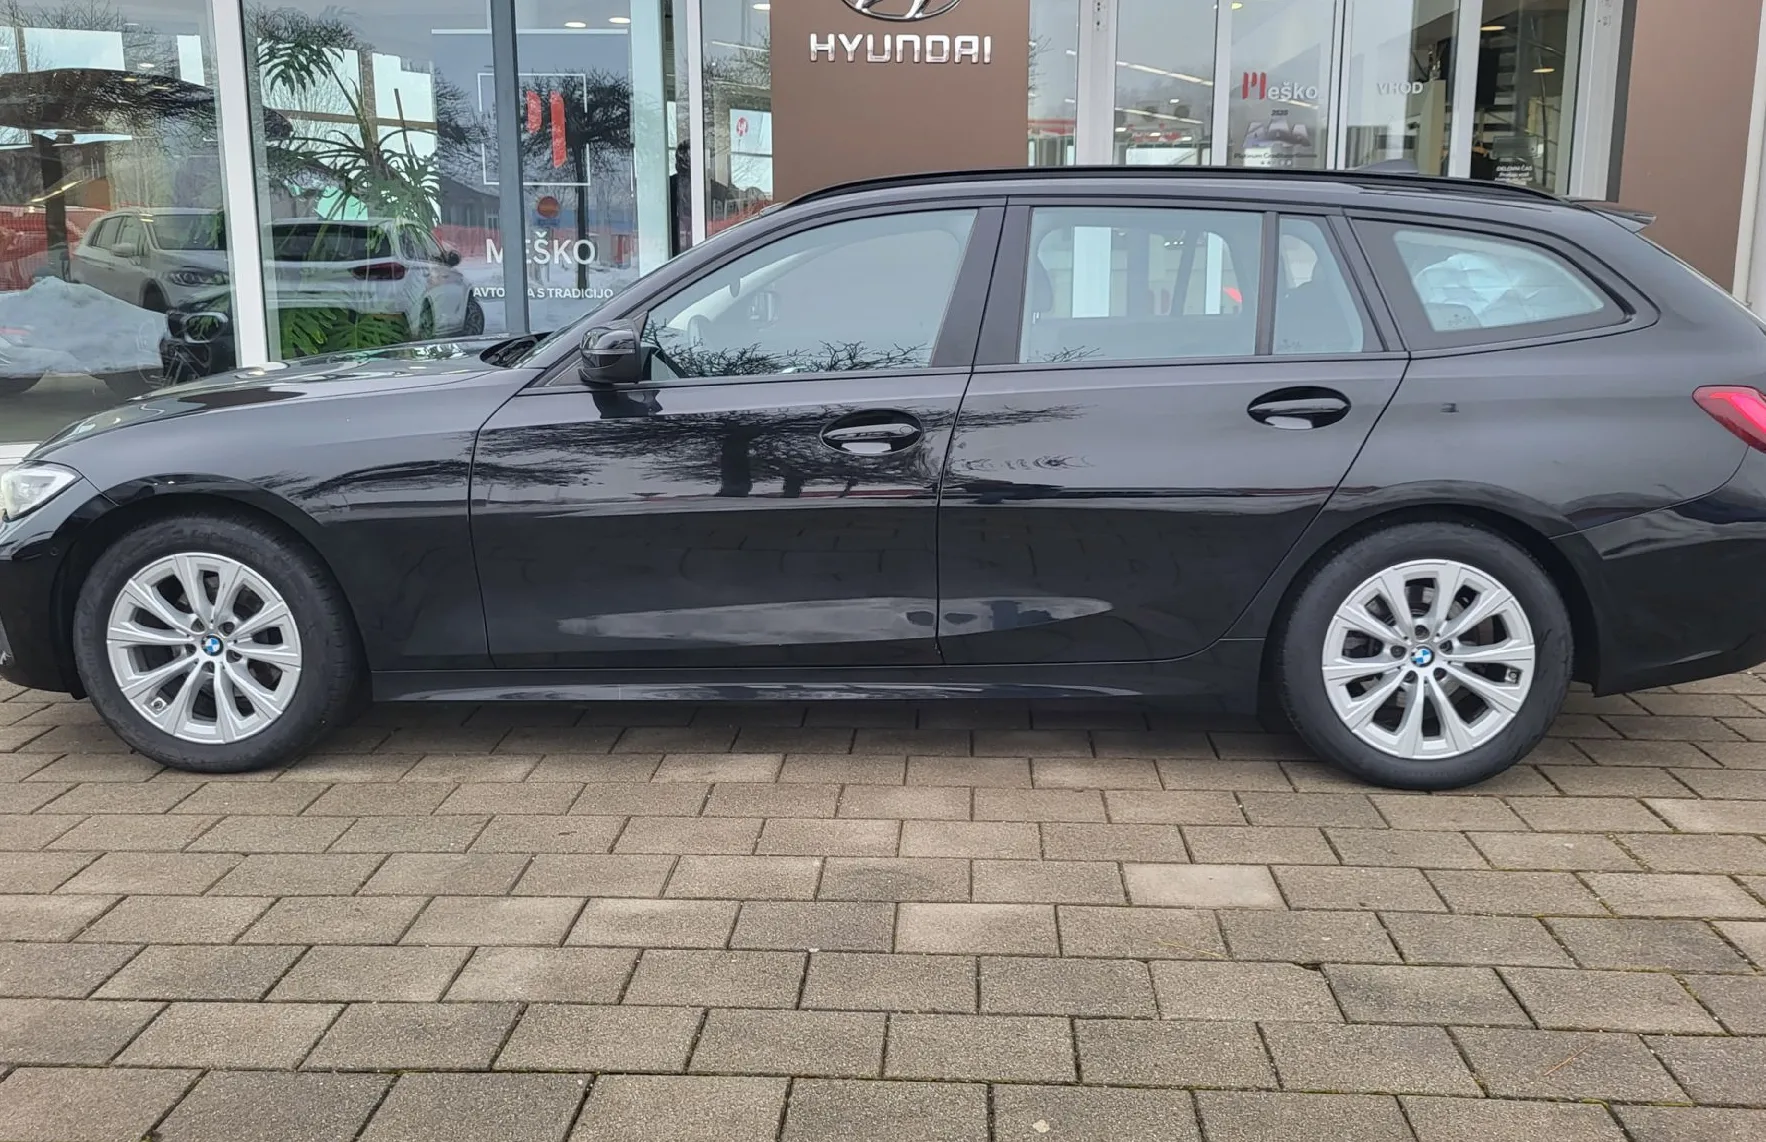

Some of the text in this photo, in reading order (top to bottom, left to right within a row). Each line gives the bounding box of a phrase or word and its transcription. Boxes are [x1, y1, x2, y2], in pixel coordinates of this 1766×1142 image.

[809, 33, 992, 64] HYUNDAI
[1376, 81, 1424, 95] VHOD
[536, 287, 545, 299] S
[547, 287, 614, 300] TRADICIJO
